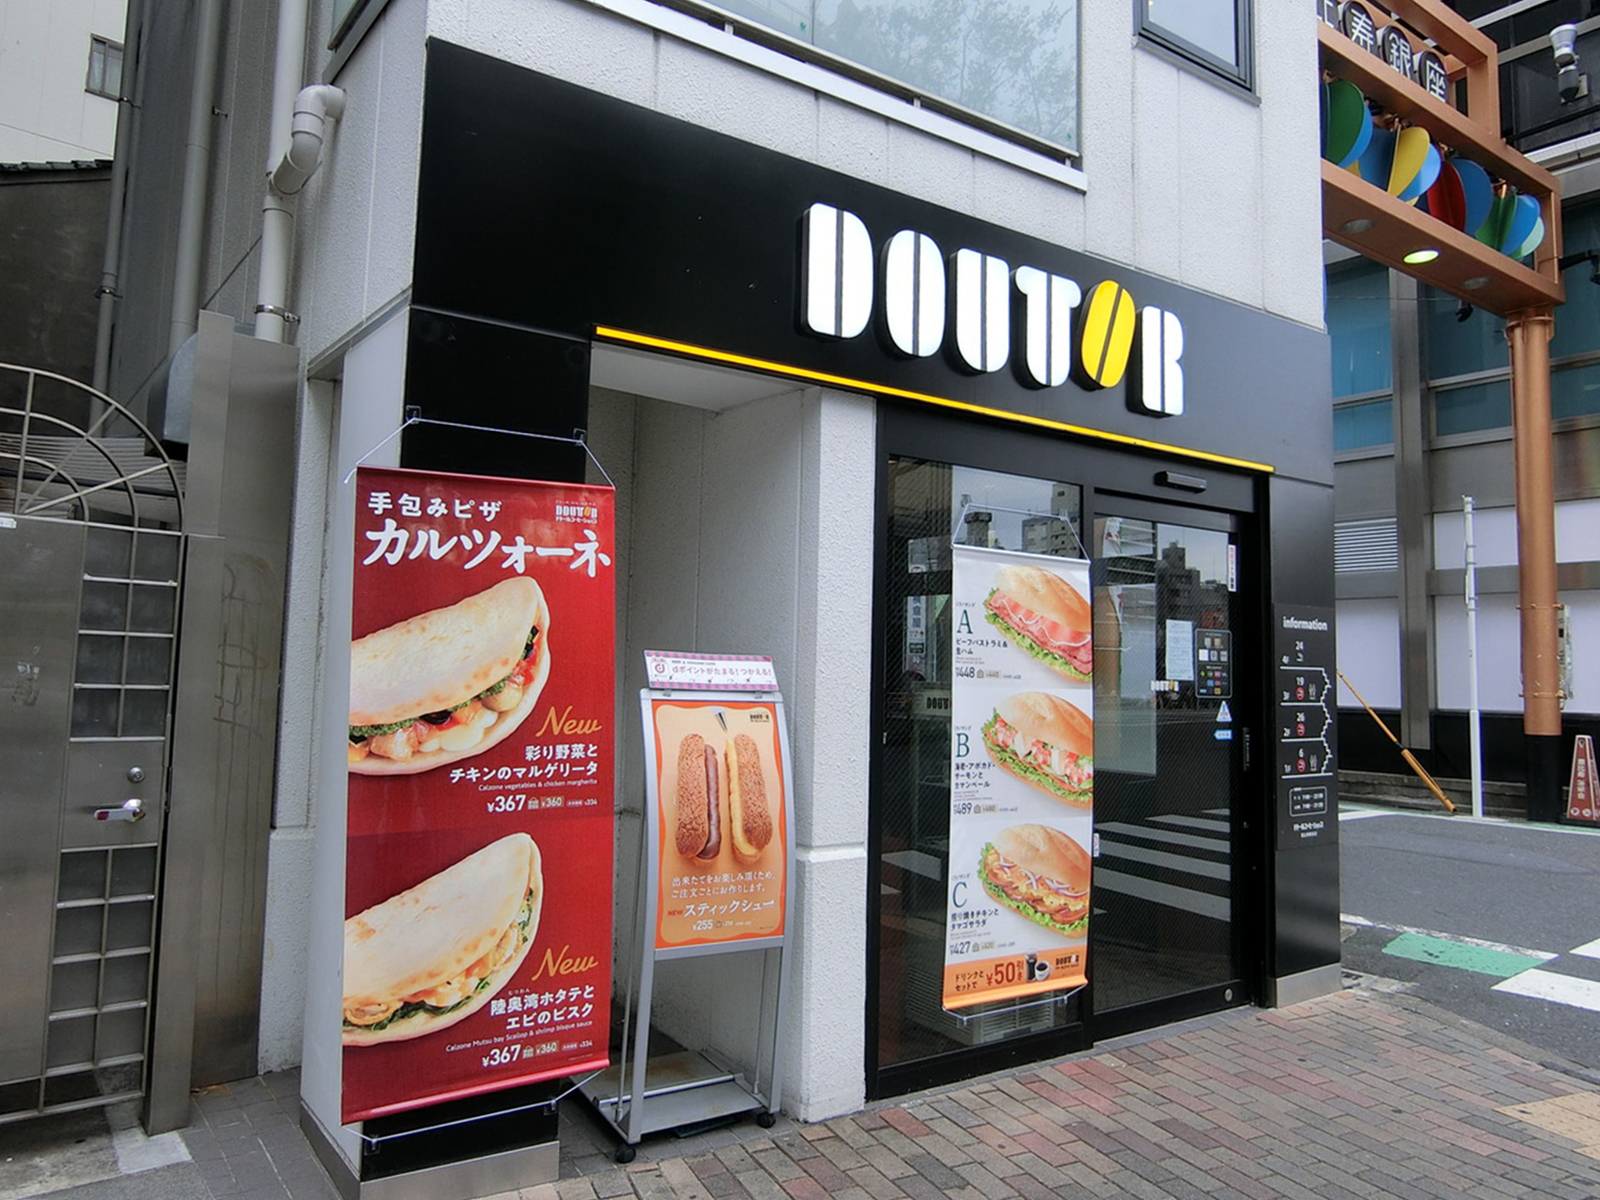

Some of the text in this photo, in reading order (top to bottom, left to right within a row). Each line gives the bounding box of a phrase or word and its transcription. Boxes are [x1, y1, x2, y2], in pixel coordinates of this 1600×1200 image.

[806, 202, 1185, 416] DOUTOR
[368, 491, 502, 522] 手包みピザ
[555, 505, 598, 518] DOUTOR
[362, 518, 612, 578] カルツォーネ
[956, 609, 974, 634] A
[1283, 616, 1328, 631] information
[1295, 641, 1304, 650] 24
[1296, 677, 1304, 686] 19
[535, 705, 602, 738] New
[525, 744, 598, 761] 彩り野菜と
[956, 733, 970, 758] B
[1298, 748, 1304, 757] 6
[450, 761, 598, 783] チキンのマルゲリータ
[952, 882, 968, 908] C
[683, 899, 775, 917] スティックシュー
[531, 944, 599, 982] New
[955, 970, 984, 982] ドリンクと
[955, 982, 978, 992] セットで
[490, 985, 594, 1016] 陸奥湾ホタテと
[506, 1003, 593, 1030] エビのビスク
